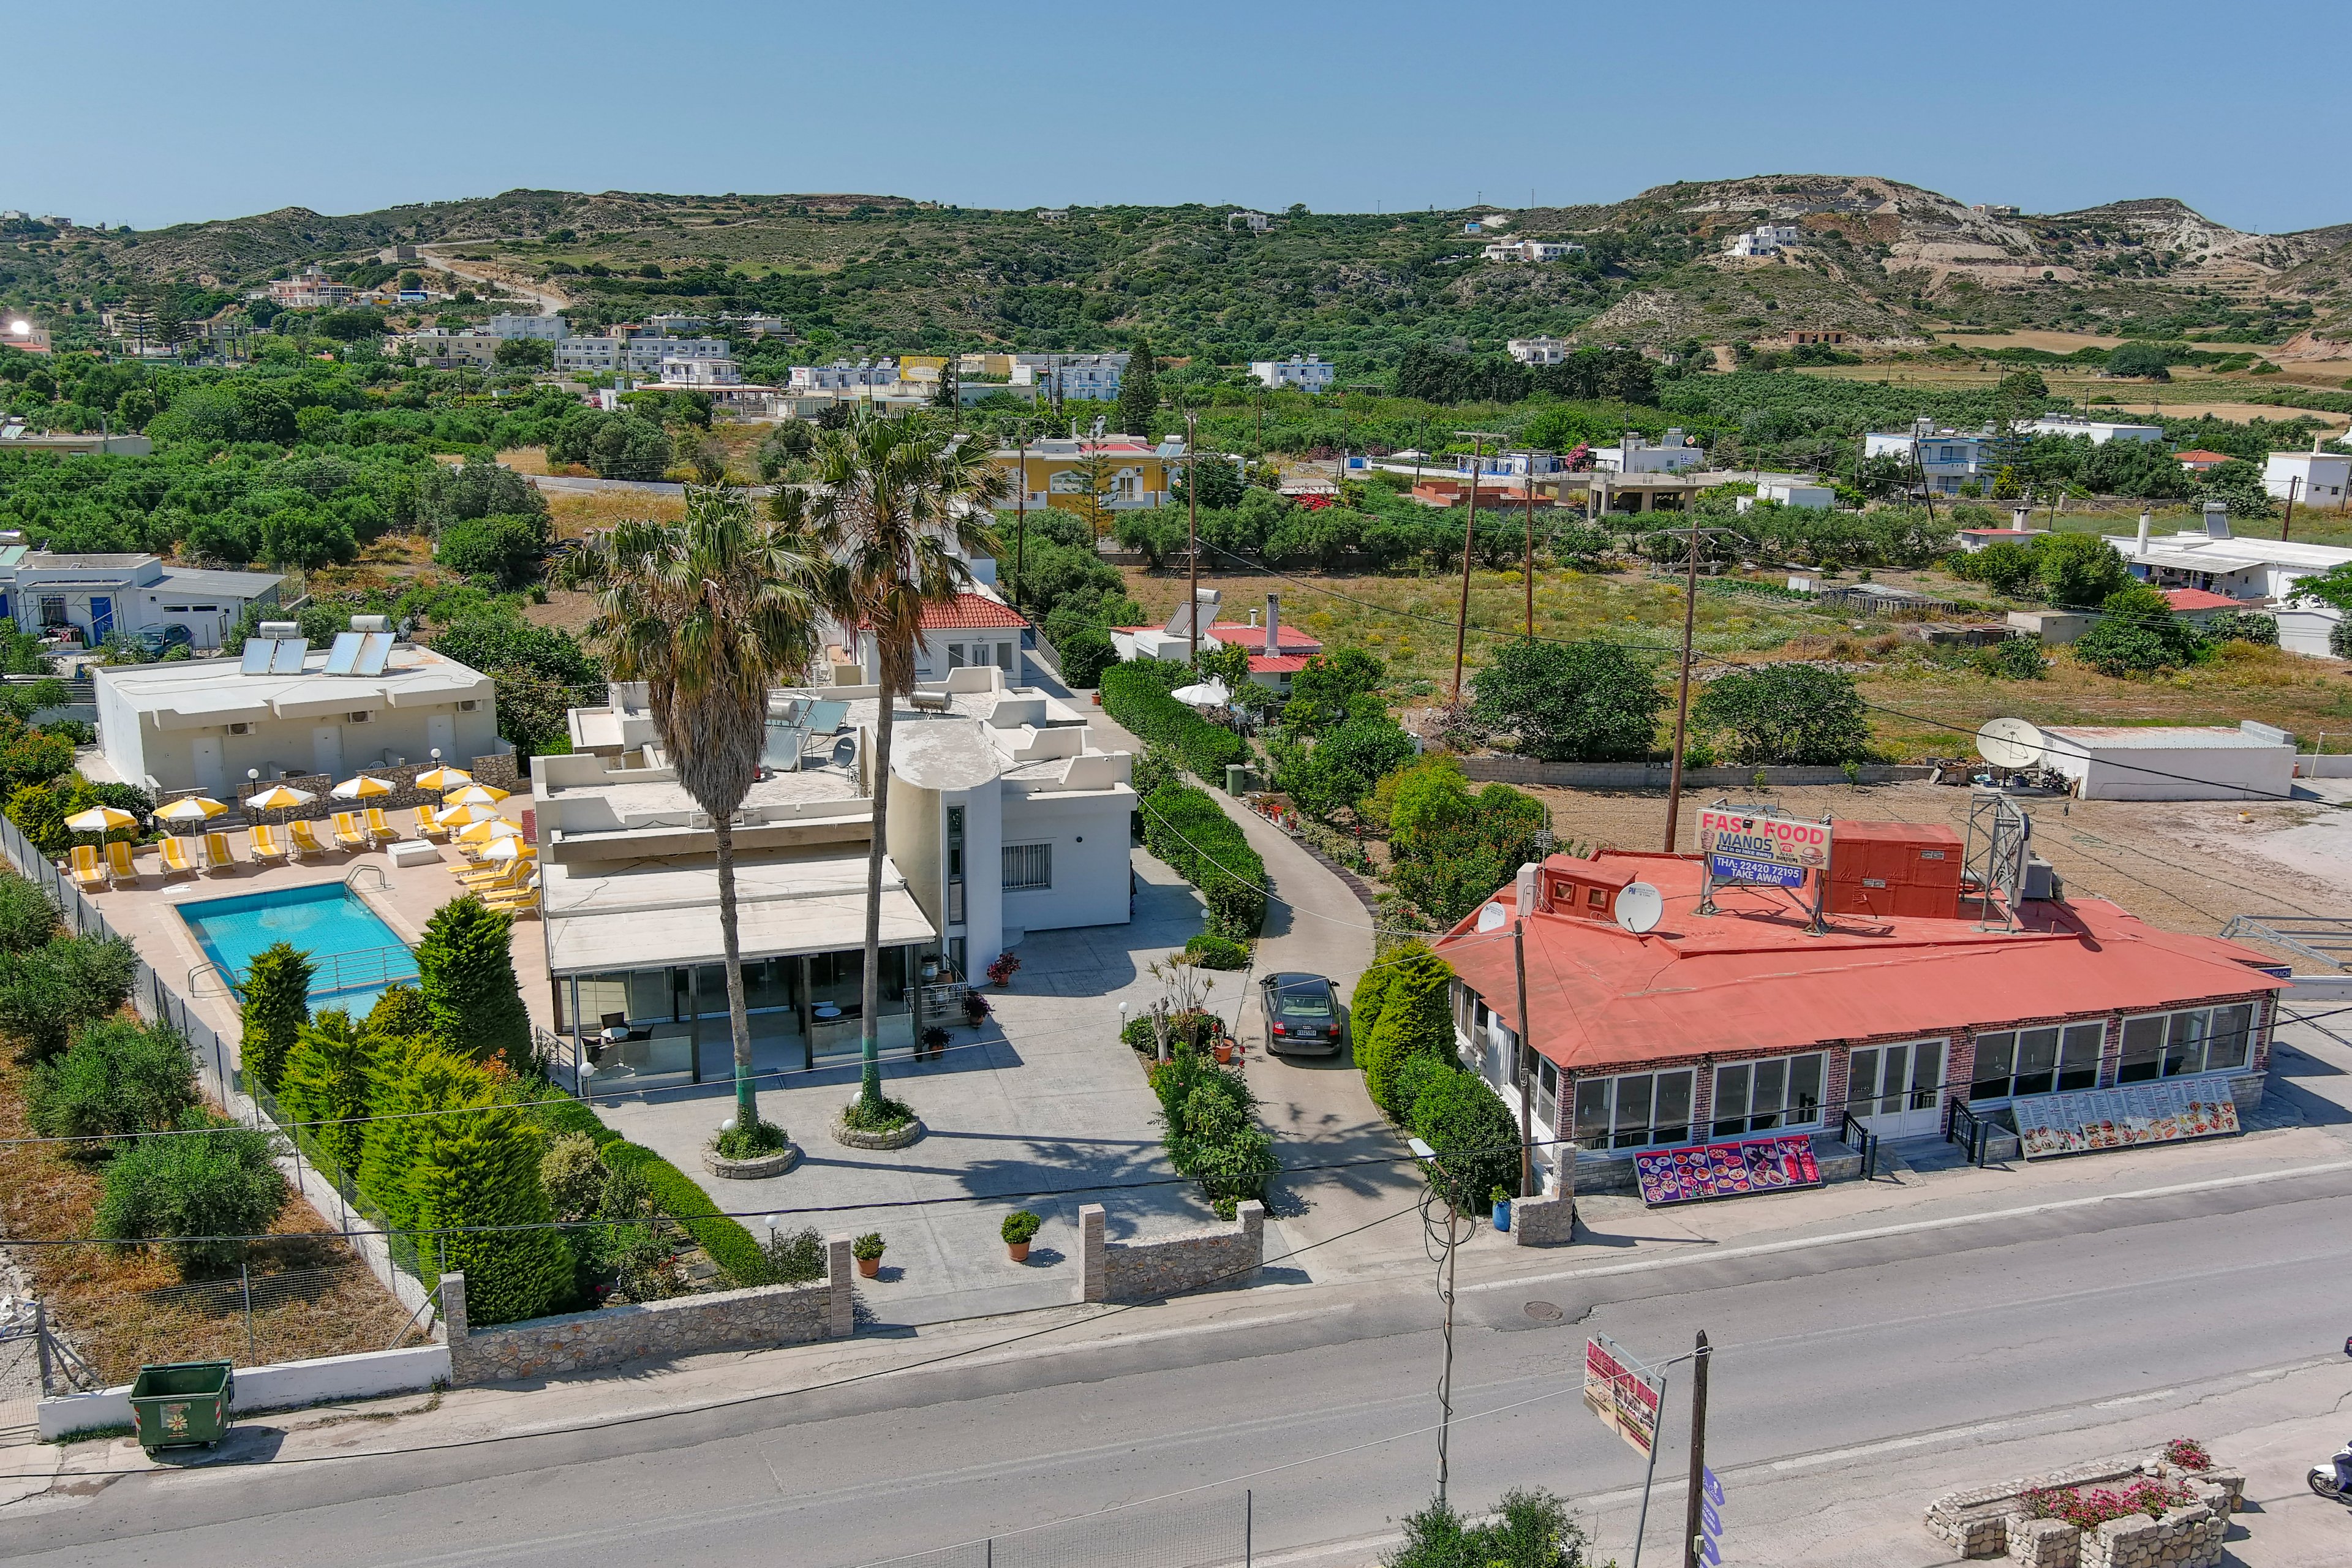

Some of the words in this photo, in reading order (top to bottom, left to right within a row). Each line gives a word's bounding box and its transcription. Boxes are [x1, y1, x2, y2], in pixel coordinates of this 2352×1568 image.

[1719, 832, 1773, 851] MANOS
[1764, 821, 1824, 845] FOOD
[1731, 868, 1754, 880] TAKE
[1756, 872, 1783, 884] AWAY
[1740, 861, 1769, 873] 22420
[1772, 865, 1800, 878] 72195
[1636, 1379, 1657, 1412] HIRE
